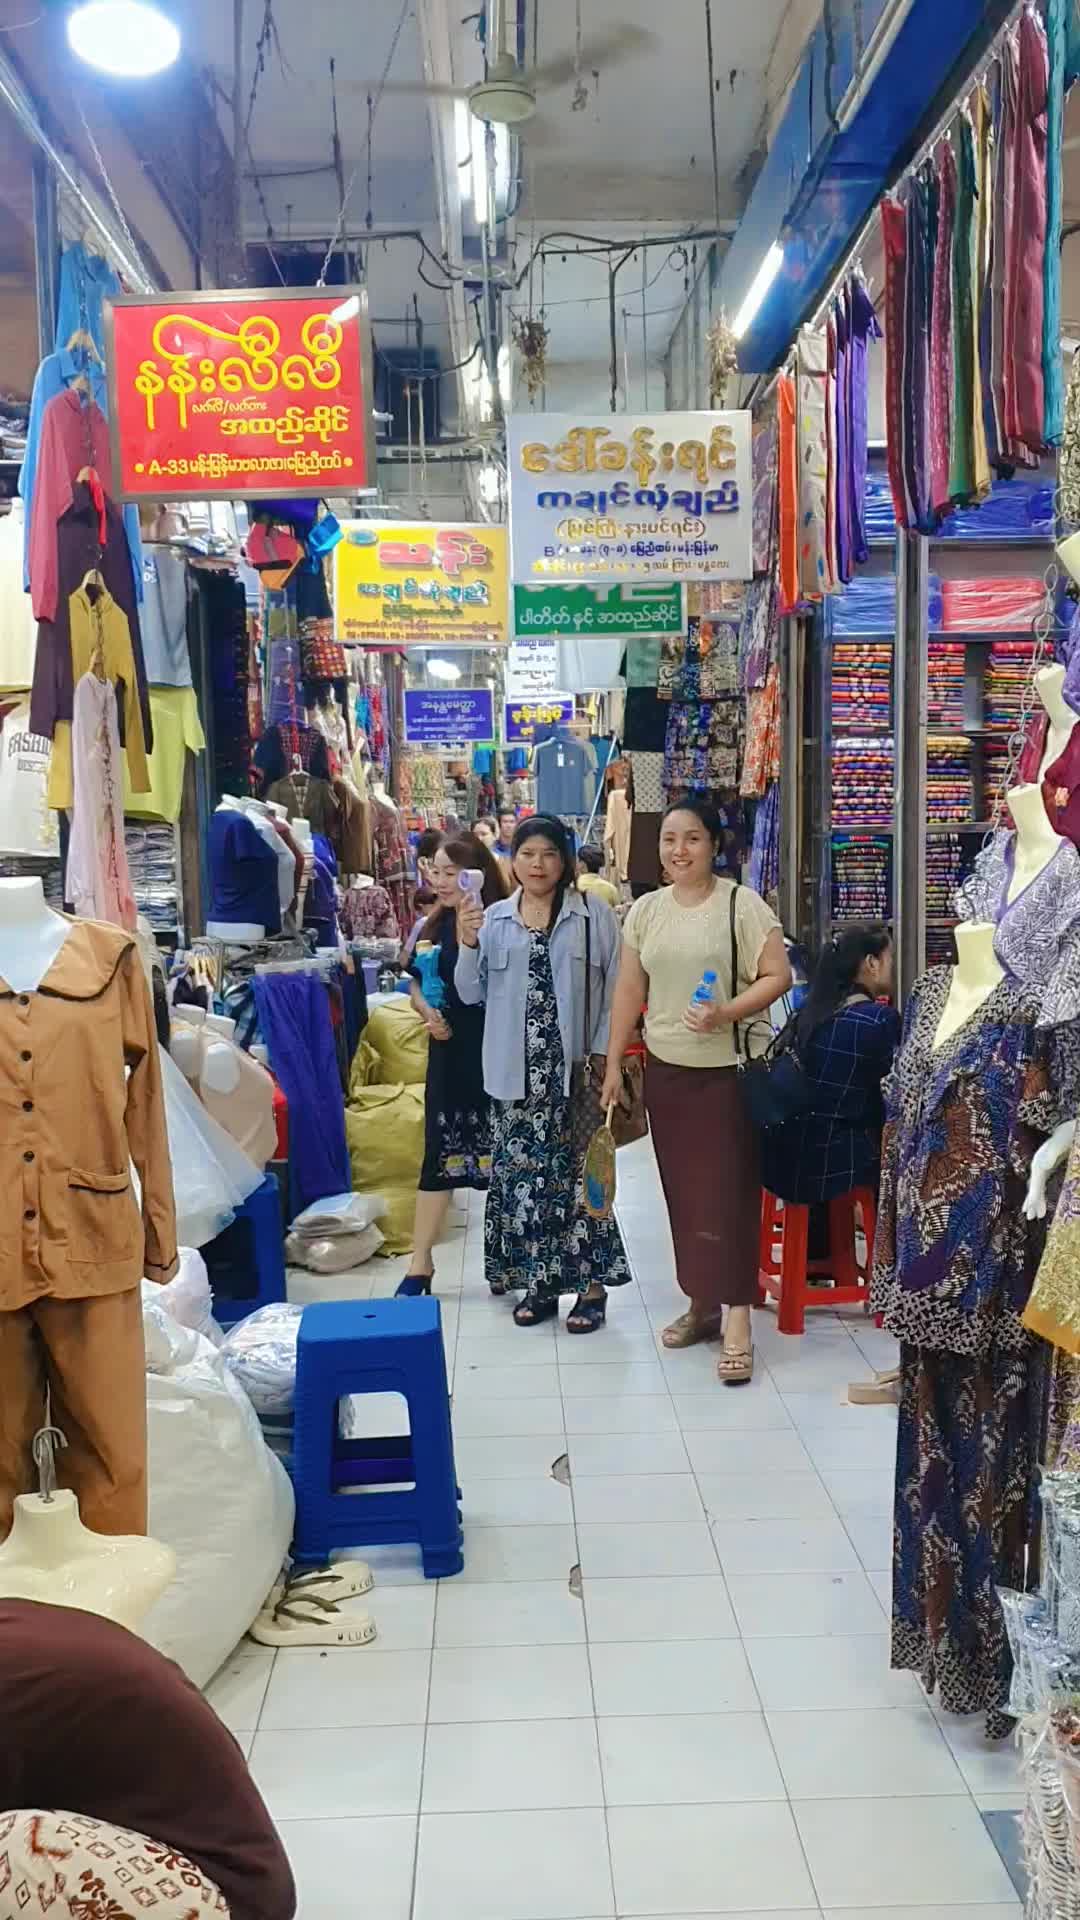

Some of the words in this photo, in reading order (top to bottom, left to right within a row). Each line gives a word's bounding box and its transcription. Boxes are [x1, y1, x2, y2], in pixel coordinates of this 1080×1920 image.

[220, 405, 350, 444] အထည်ဆိုင်
[148, 460, 187, 474] A-33
[537, 480, 739, 516] ကချင်လုံချည်
